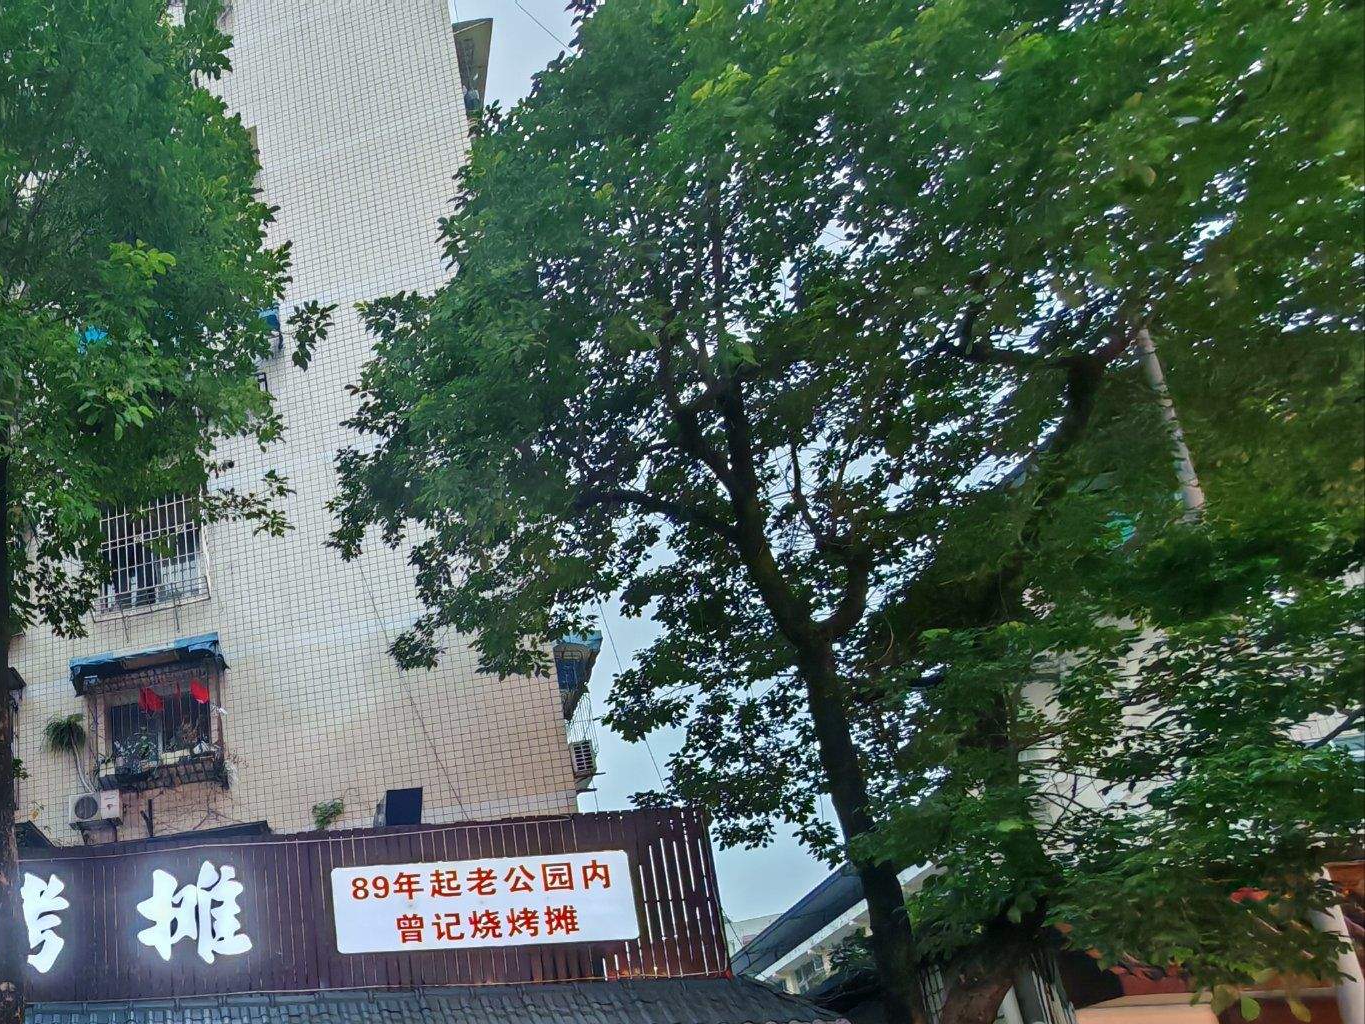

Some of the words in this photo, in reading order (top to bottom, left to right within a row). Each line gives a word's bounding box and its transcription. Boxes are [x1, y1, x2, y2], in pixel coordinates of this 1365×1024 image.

[351, 859, 612, 900] 89年起老公园内
[395, 904, 581, 944] 曾记烧烤摊
